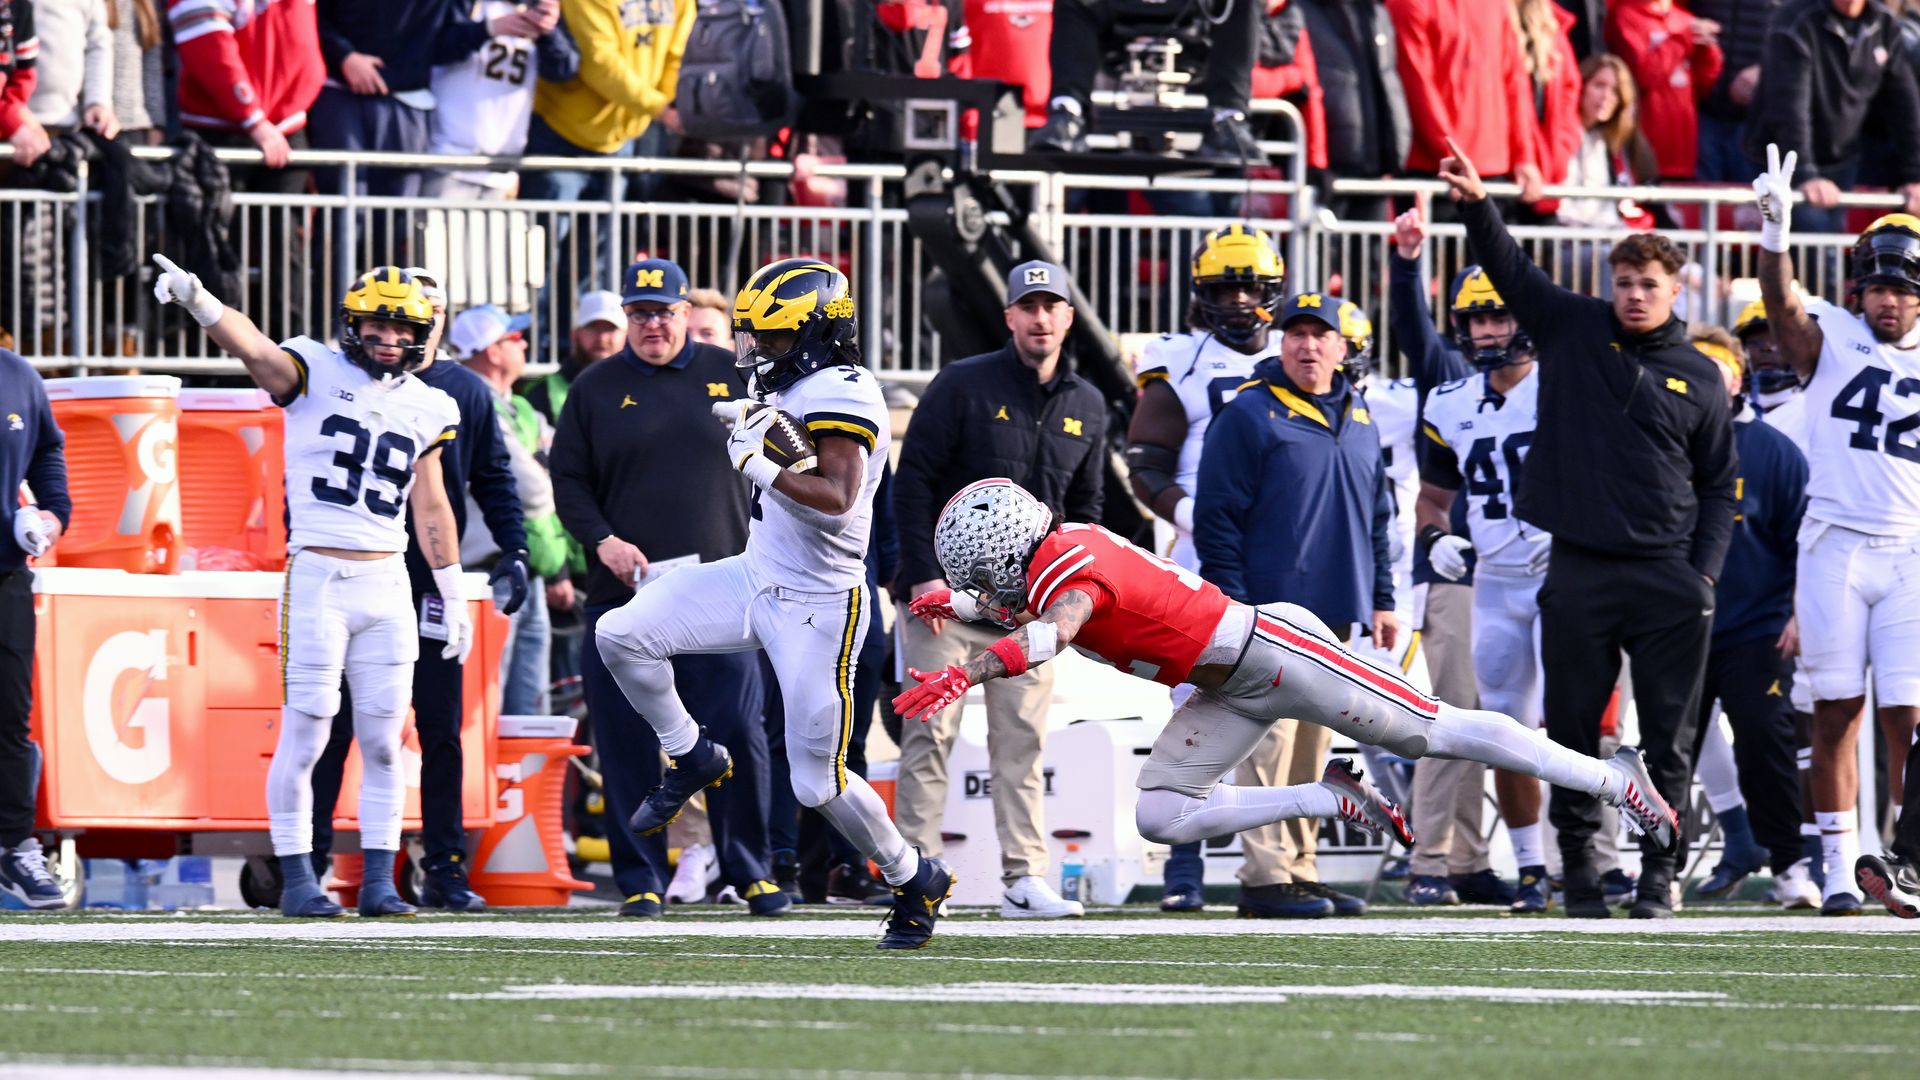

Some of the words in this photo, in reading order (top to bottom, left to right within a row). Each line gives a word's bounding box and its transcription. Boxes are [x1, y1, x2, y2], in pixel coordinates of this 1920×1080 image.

[485, 43, 529, 86] 25
[636, 269, 664, 288] M
[1029, 271, 1045, 282] M
[1297, 294, 1322, 308] M
[706, 382, 731, 398] M
[1063, 417, 1084, 436] M
[1830, 365, 1920, 464] 42
[137, 415, 177, 485] G
[311, 413, 416, 521] 39
[83, 629, 172, 785] G
